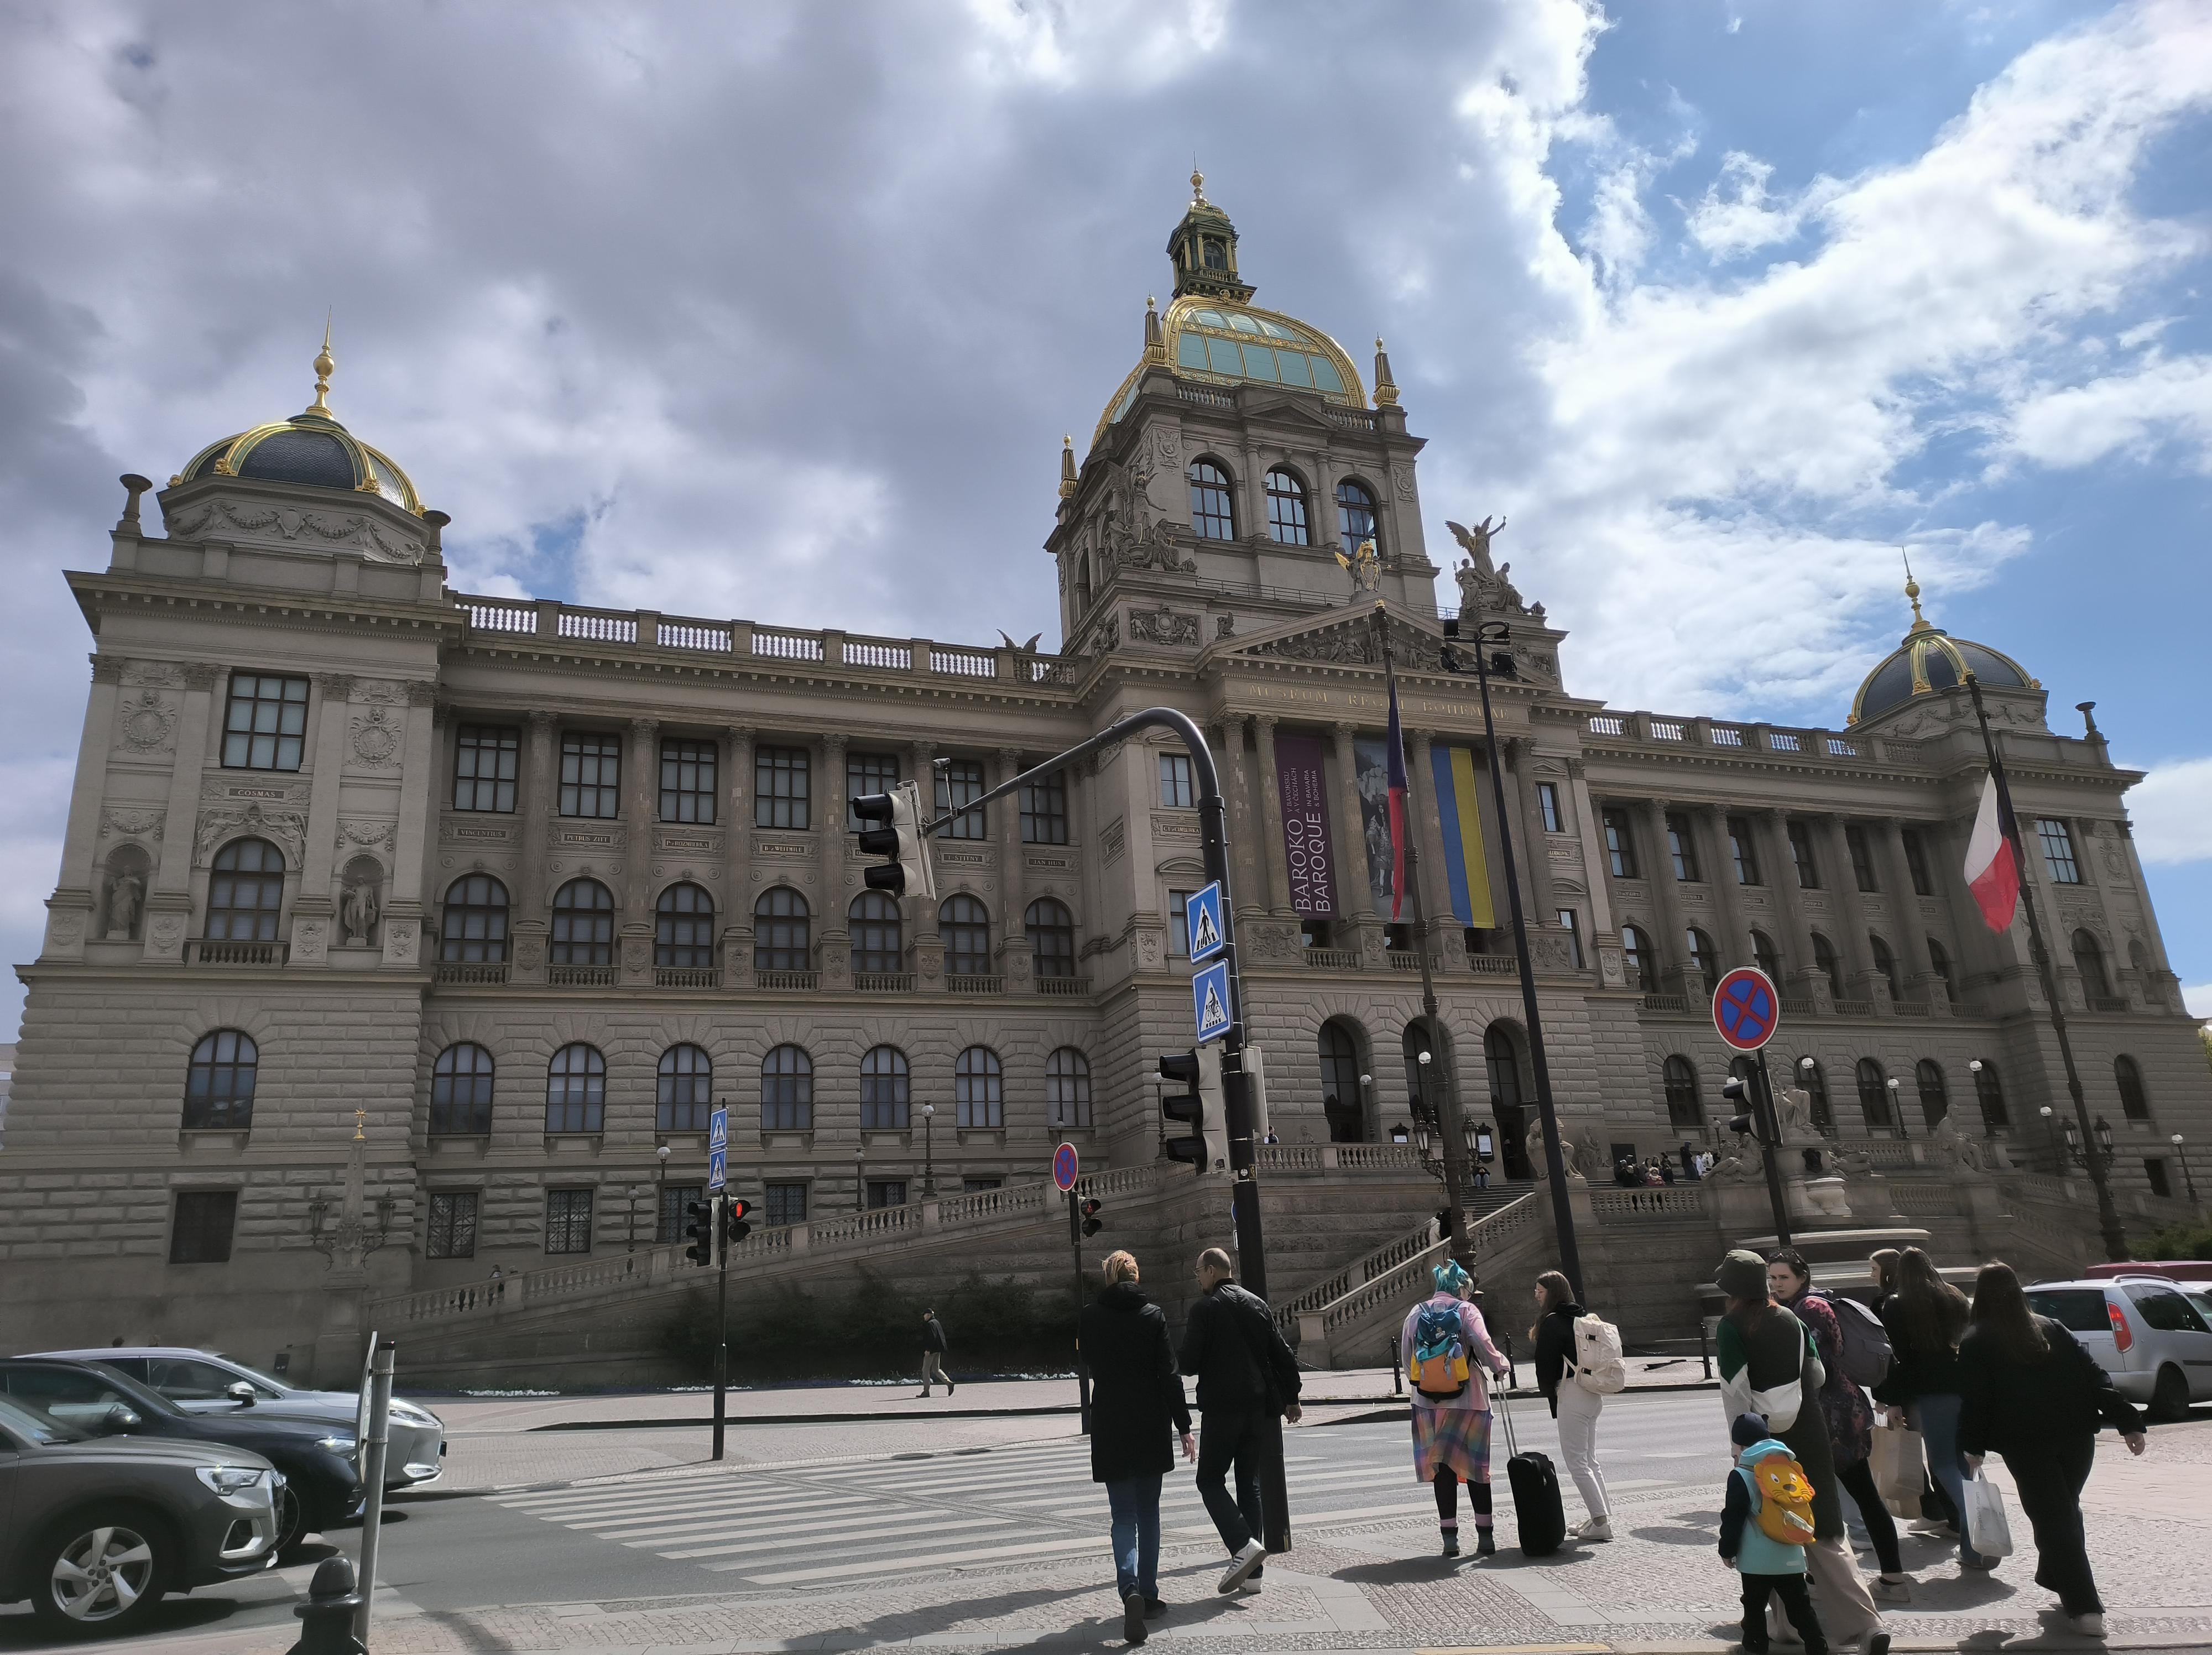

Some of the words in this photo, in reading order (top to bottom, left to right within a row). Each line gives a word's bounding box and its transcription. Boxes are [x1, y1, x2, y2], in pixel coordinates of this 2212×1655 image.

[1250, 685, 1327, 702] MUSEUM
[1423, 702, 1509, 719] BOHEMAE
[1284, 771, 1292, 806] BAVORSKU
[1290, 768, 1299, 801] ČECHÁCH
[1287, 819, 1312, 912] BAROKO
[1306, 812, 1331, 912] BAROQUE
